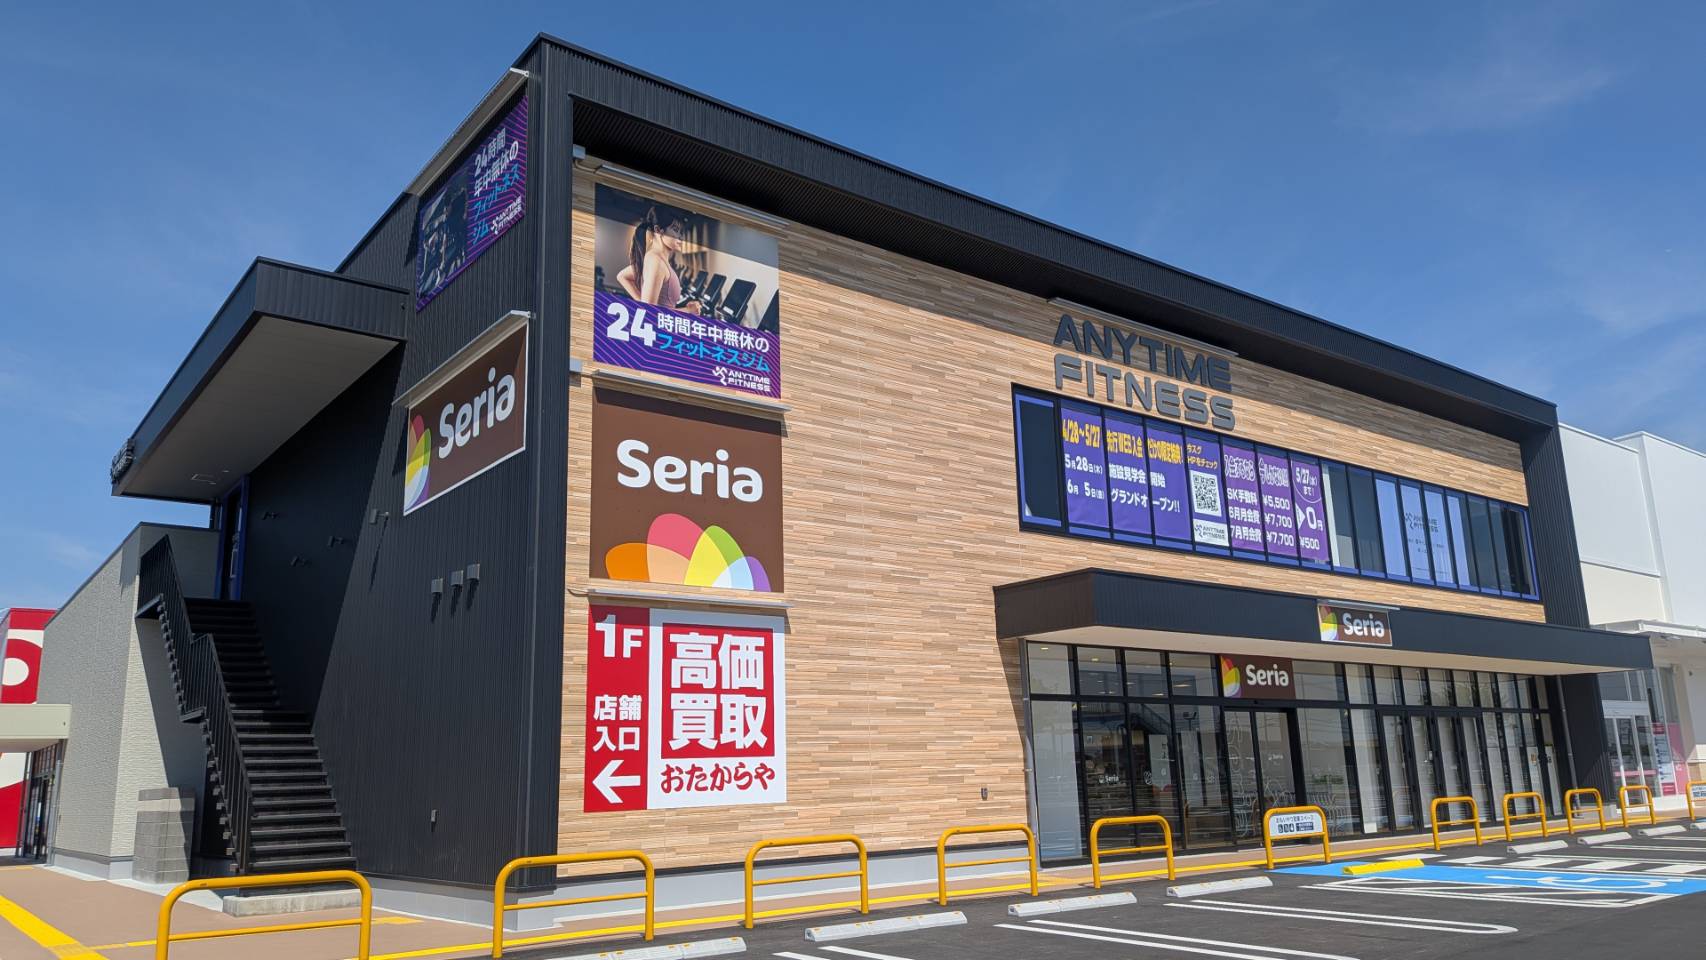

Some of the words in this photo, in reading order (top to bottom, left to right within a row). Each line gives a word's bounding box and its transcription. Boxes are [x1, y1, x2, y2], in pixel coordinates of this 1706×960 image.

[473, 140, 519, 197] 年中無休の
[474, 127, 506, 176] 24時間
[473, 163, 520, 221] フィットネス
[657, 333, 771, 373] フィットネスジム
[1053, 313, 1233, 393] ANYTIME
[728, 370, 771, 385] ANYTIME
[728, 377, 771, 392] FITNESS
[1054, 353, 1236, 431] FITNESS
[438, 366, 516, 459] Seria
[616, 439, 764, 502] Seria
[595, 614, 644, 658] 1F
[1342, 612, 1386, 638] Seria
[669, 632, 766, 690] 高価
[1245, 663, 1290, 687] Seria
[593, 694, 643, 721] 店舗
[668, 692, 768, 751] 買取
[592, 726, 641, 752] 入口
[660, 761, 775, 794] おたからや
